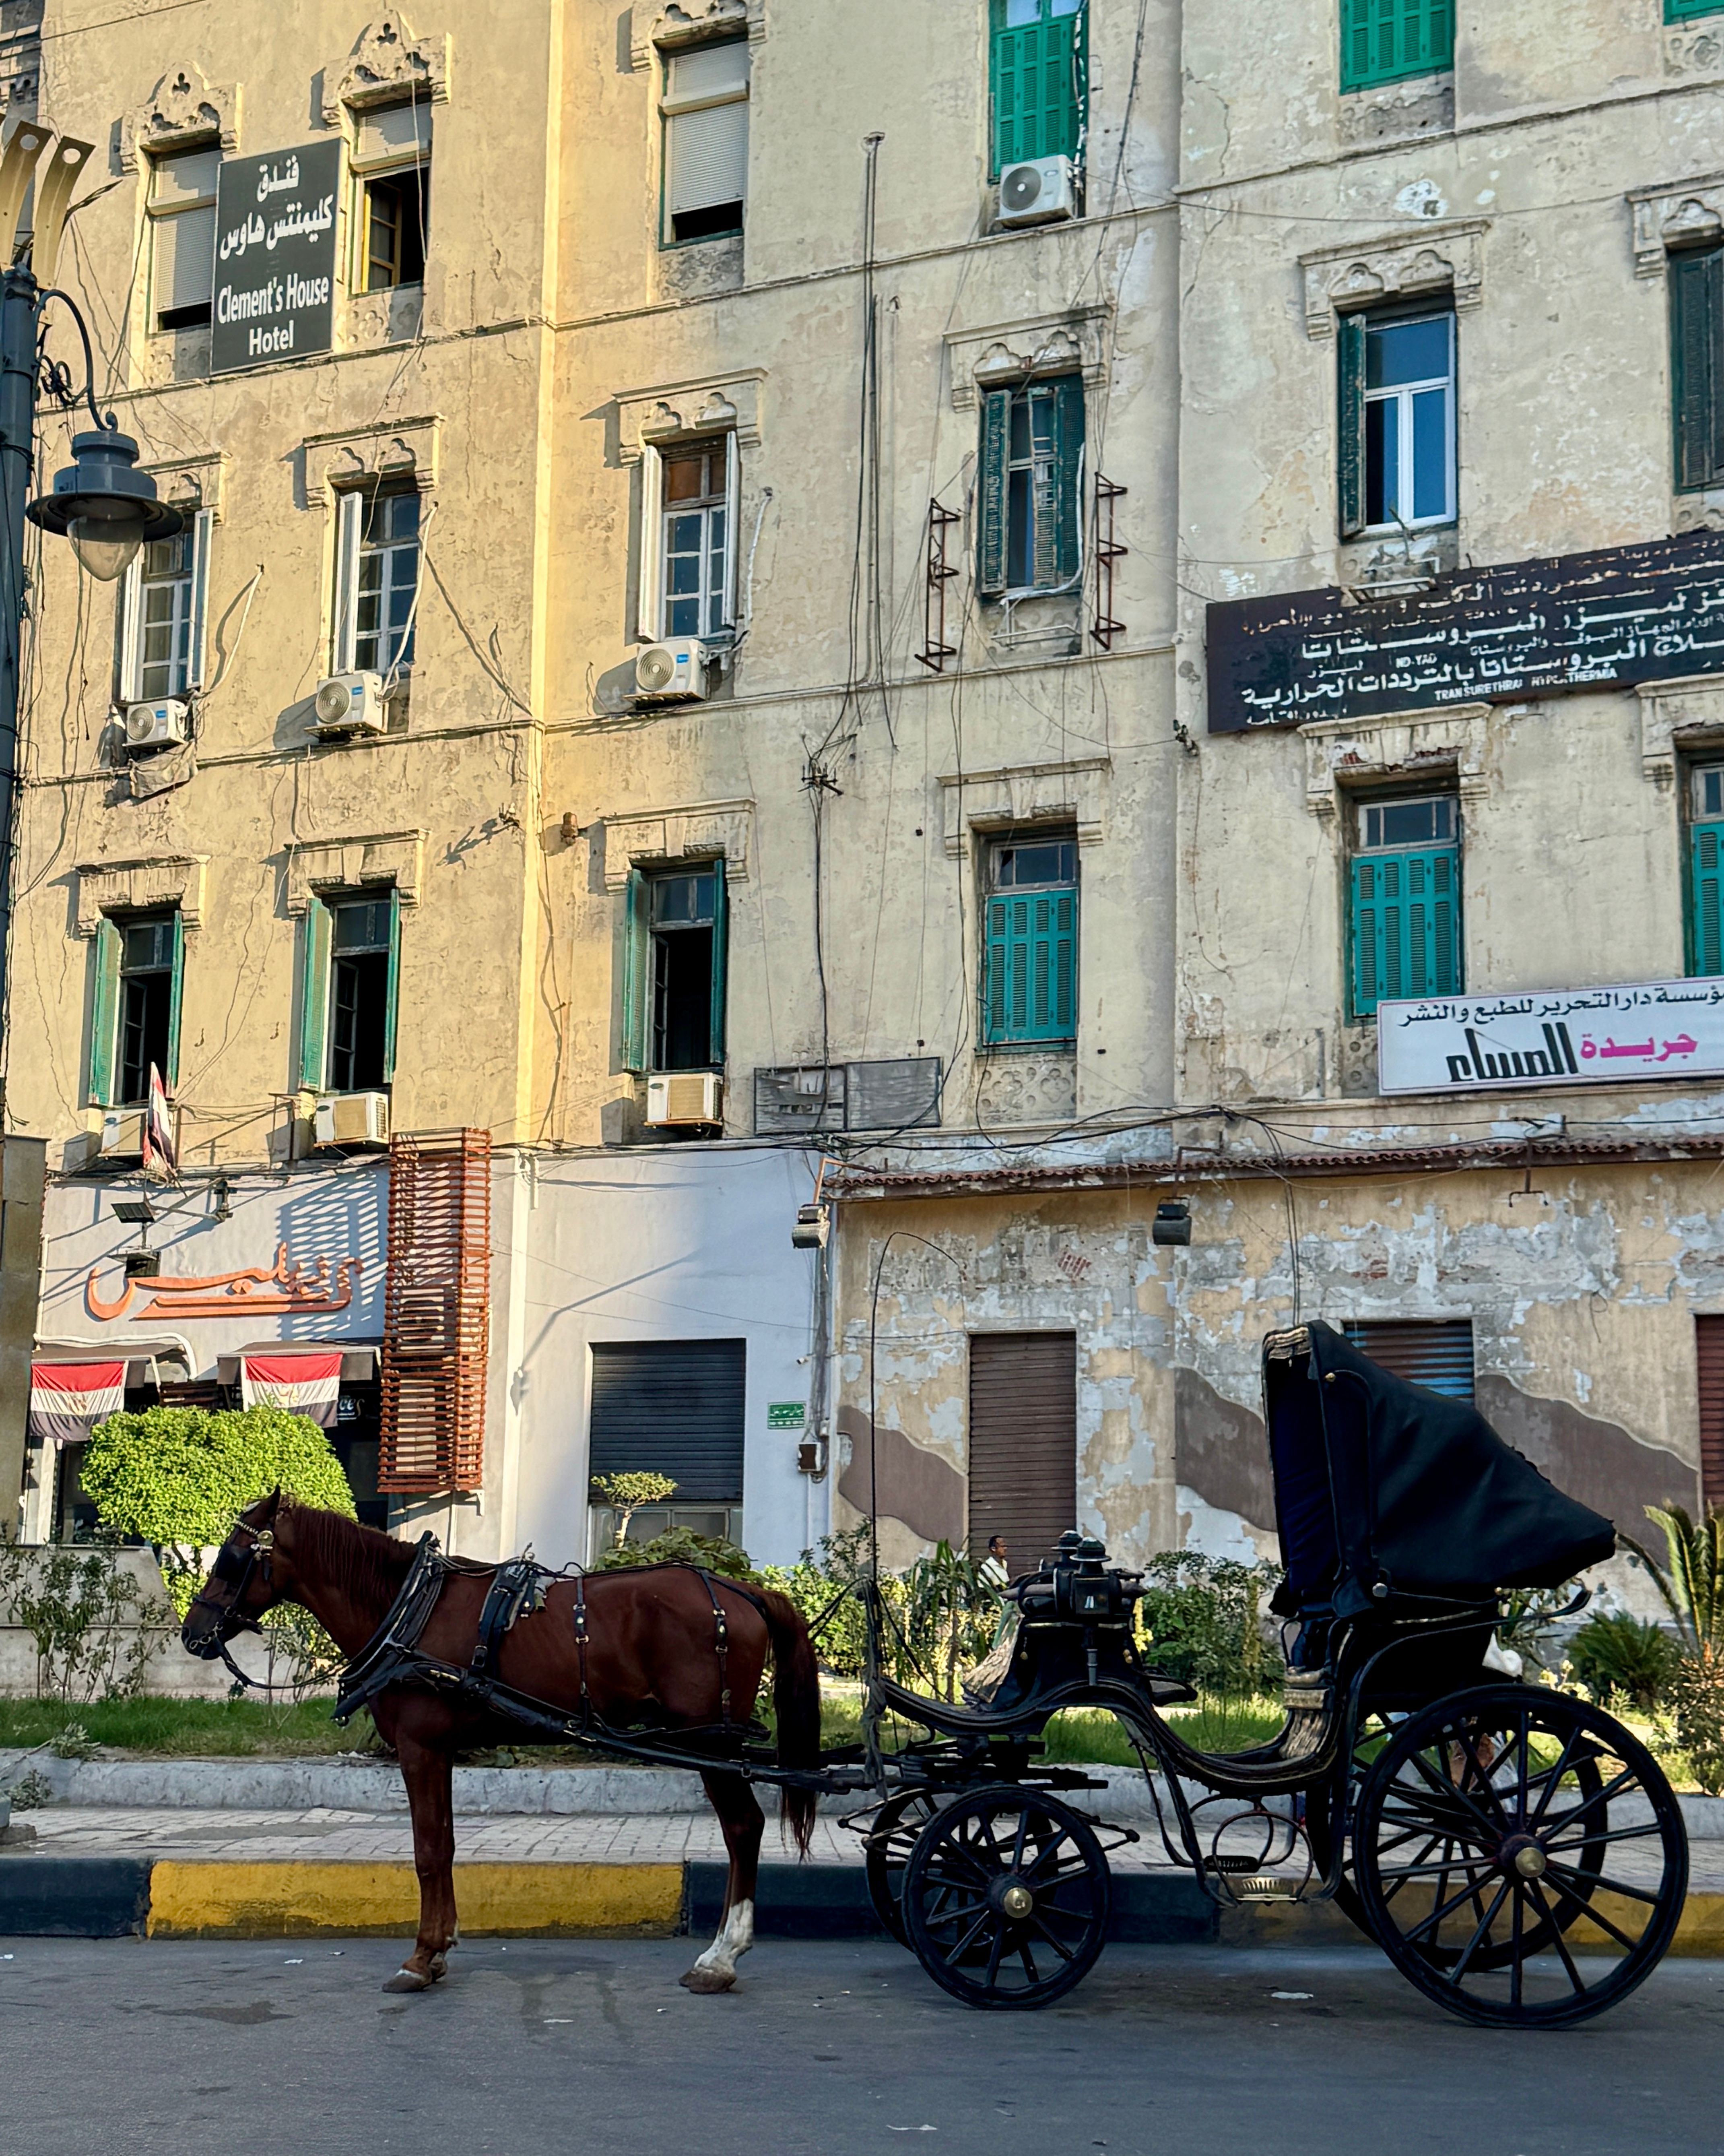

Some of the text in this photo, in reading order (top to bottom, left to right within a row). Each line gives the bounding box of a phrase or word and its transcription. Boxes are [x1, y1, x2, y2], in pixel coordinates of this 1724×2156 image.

[257, 155, 299, 202] فندق
[220, 194, 334, 260] كليمنتس هاوس
[218, 273, 329, 324] Clement's House
[249, 320, 294, 355] Hotel
[1357, 661, 1474, 692] بالترددات
[1479, 638, 1646, 677] البروستاتا
[1241, 677, 1353, 709] الحرارية
[1398, 985, 1724, 1027] ؤسسة دار التحرير للطبع والنشر
[1446, 1022, 1698, 1082] جريدة المساء
